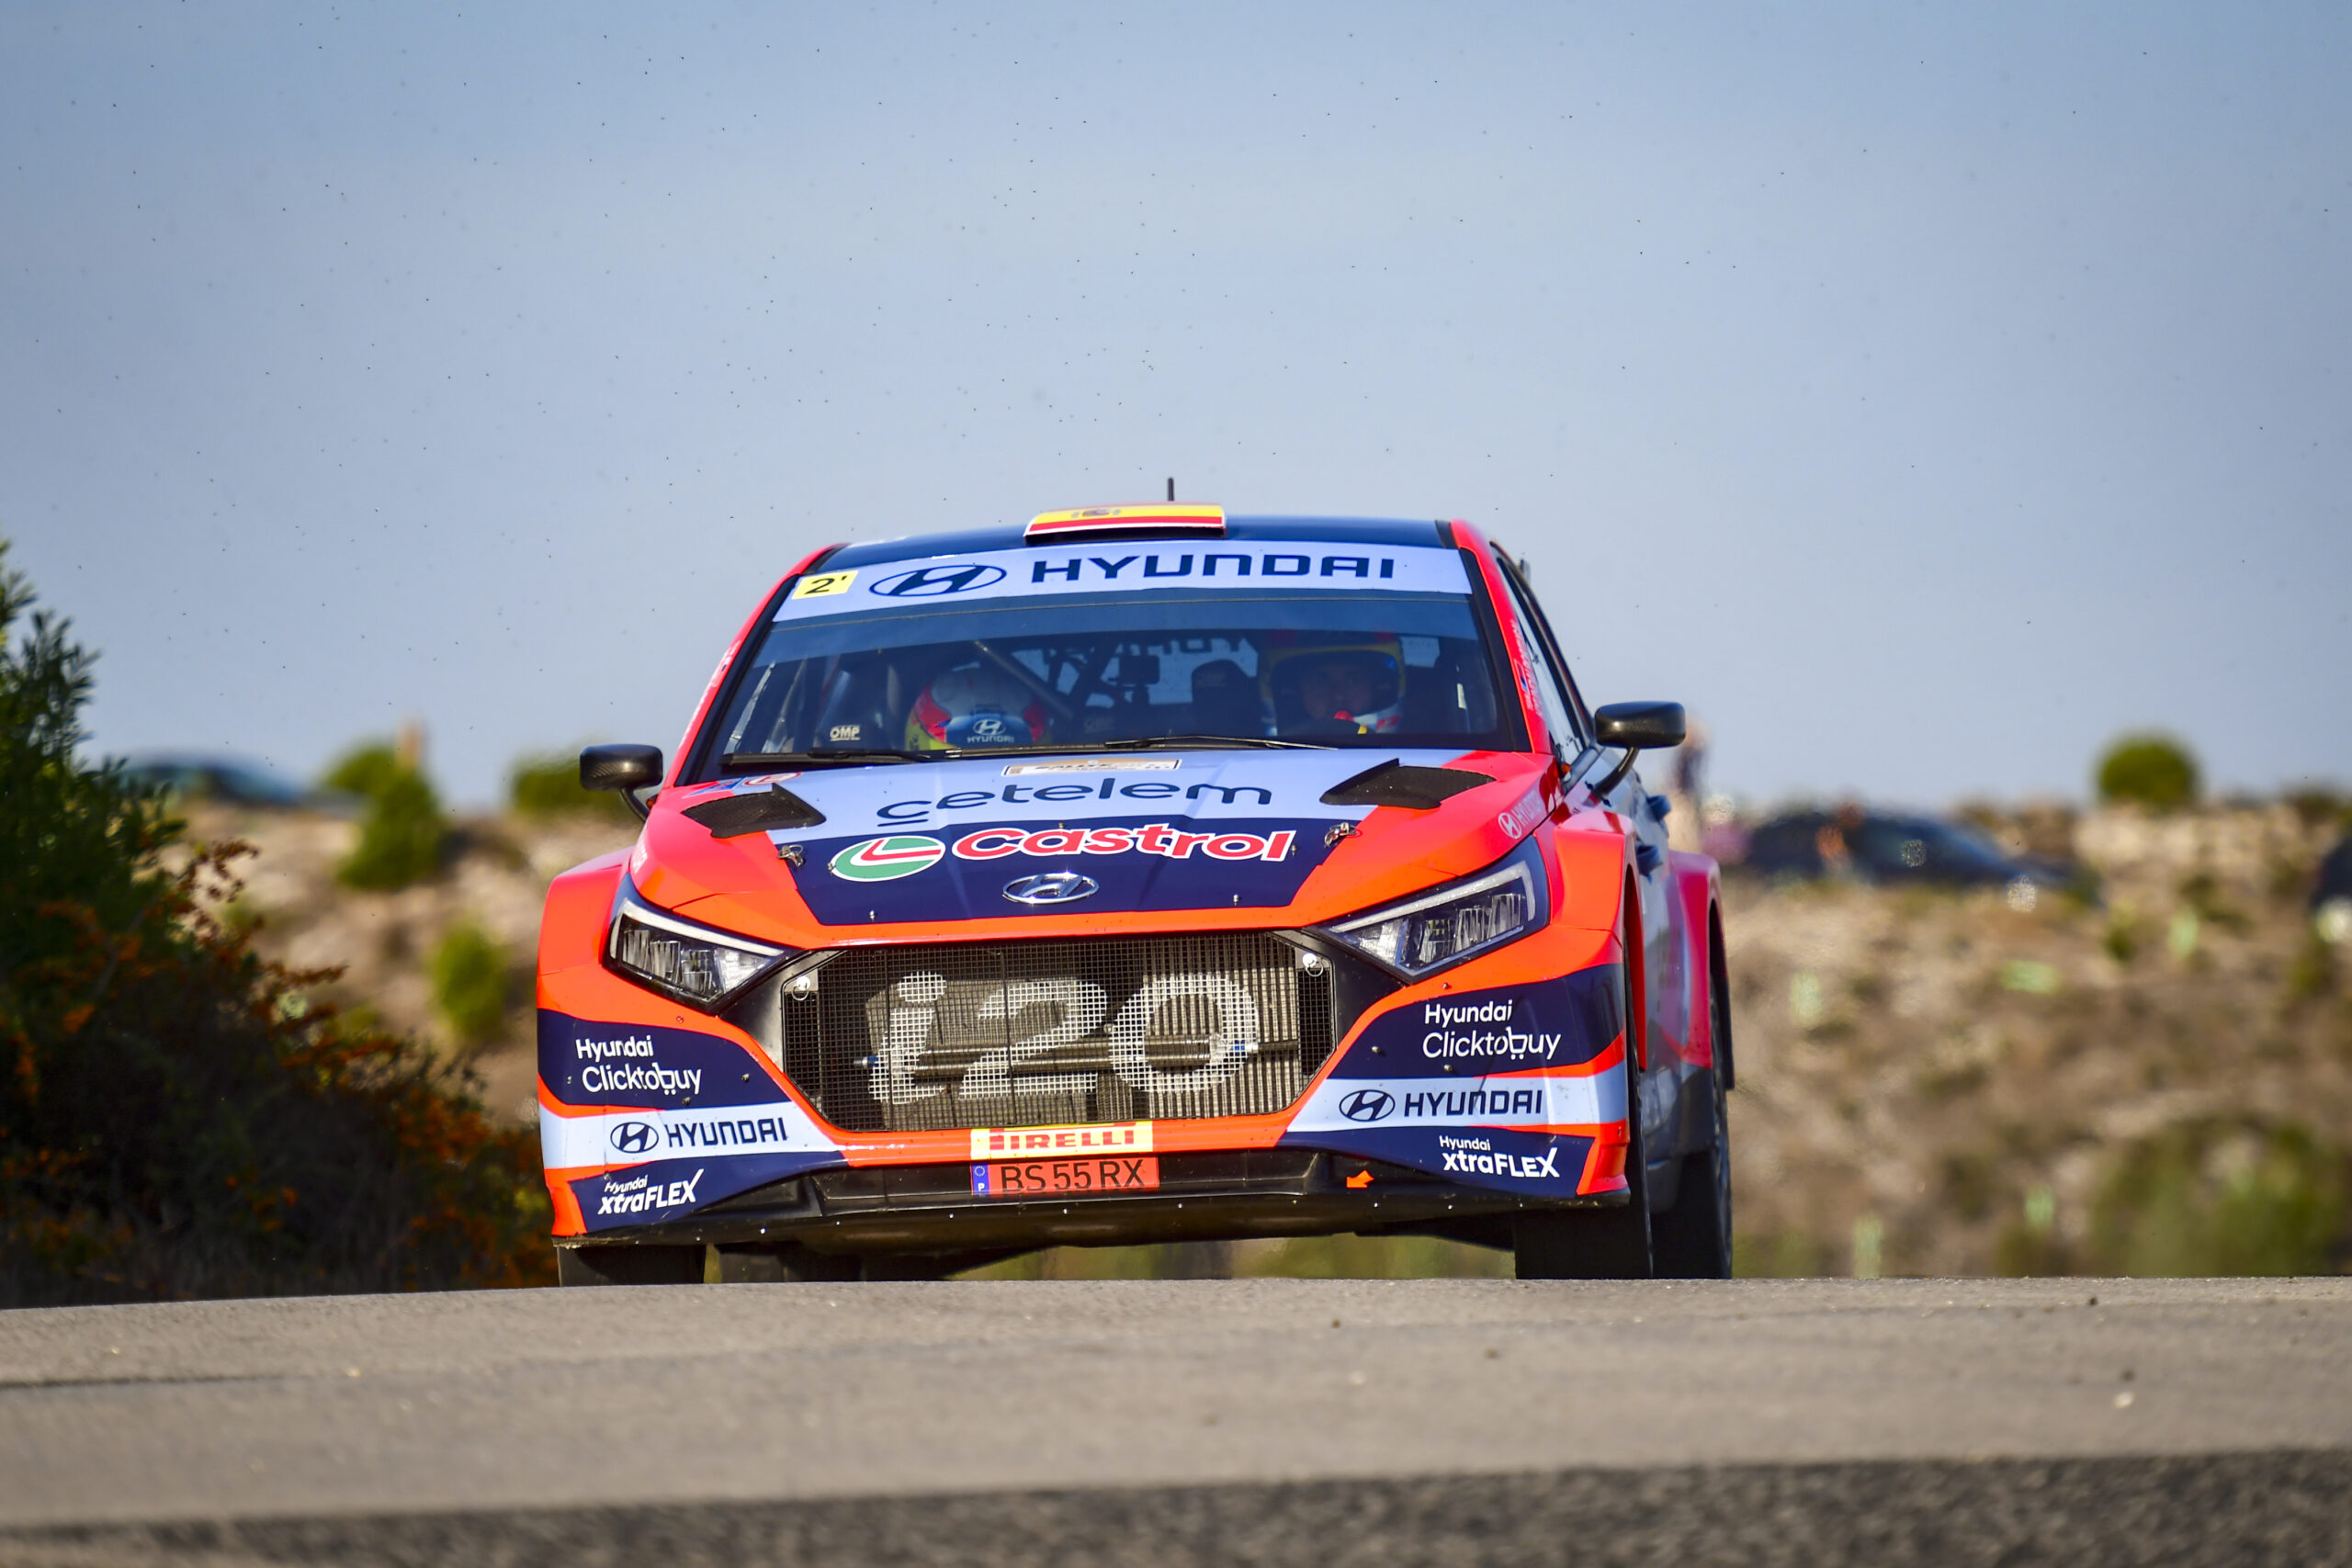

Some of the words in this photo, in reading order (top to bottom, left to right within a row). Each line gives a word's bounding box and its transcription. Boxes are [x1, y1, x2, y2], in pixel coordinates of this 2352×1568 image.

[1032, 554, 1394, 582] HYUNDAI
[830, 726, 860, 739] OMP
[967, 735, 1014, 743] HYUNDAI
[877, 778, 1272, 824] cetelem
[952, 823, 1295, 861] Castrol
[1424, 999, 1512, 1028] Hyundai
[575, 1035, 653, 1062] Hyundai
[868, 971, 1258, 1103] i20
[1422, 1027, 1561, 1060] Clicktobuy
[582, 1063, 702, 1095] Clicktobuy
[1404, 1090, 1543, 1117] HYUNDAI
[665, 1117, 787, 1147] HYUNDAI
[989, 1122, 1136, 1150] PIRELLI
[1439, 1135, 1490, 1152] Hyundai
[1001, 1165, 1046, 1191] BS
[1053, 1162, 1091, 1190] 55
[1100, 1159, 1144, 1188] RX
[1442, 1147, 1560, 1178] xtraFLEX
[597, 1168, 705, 1214] xtraFLEX
[605, 1175, 648, 1192] Hyundai
[978, 1183, 985, 1191] P
